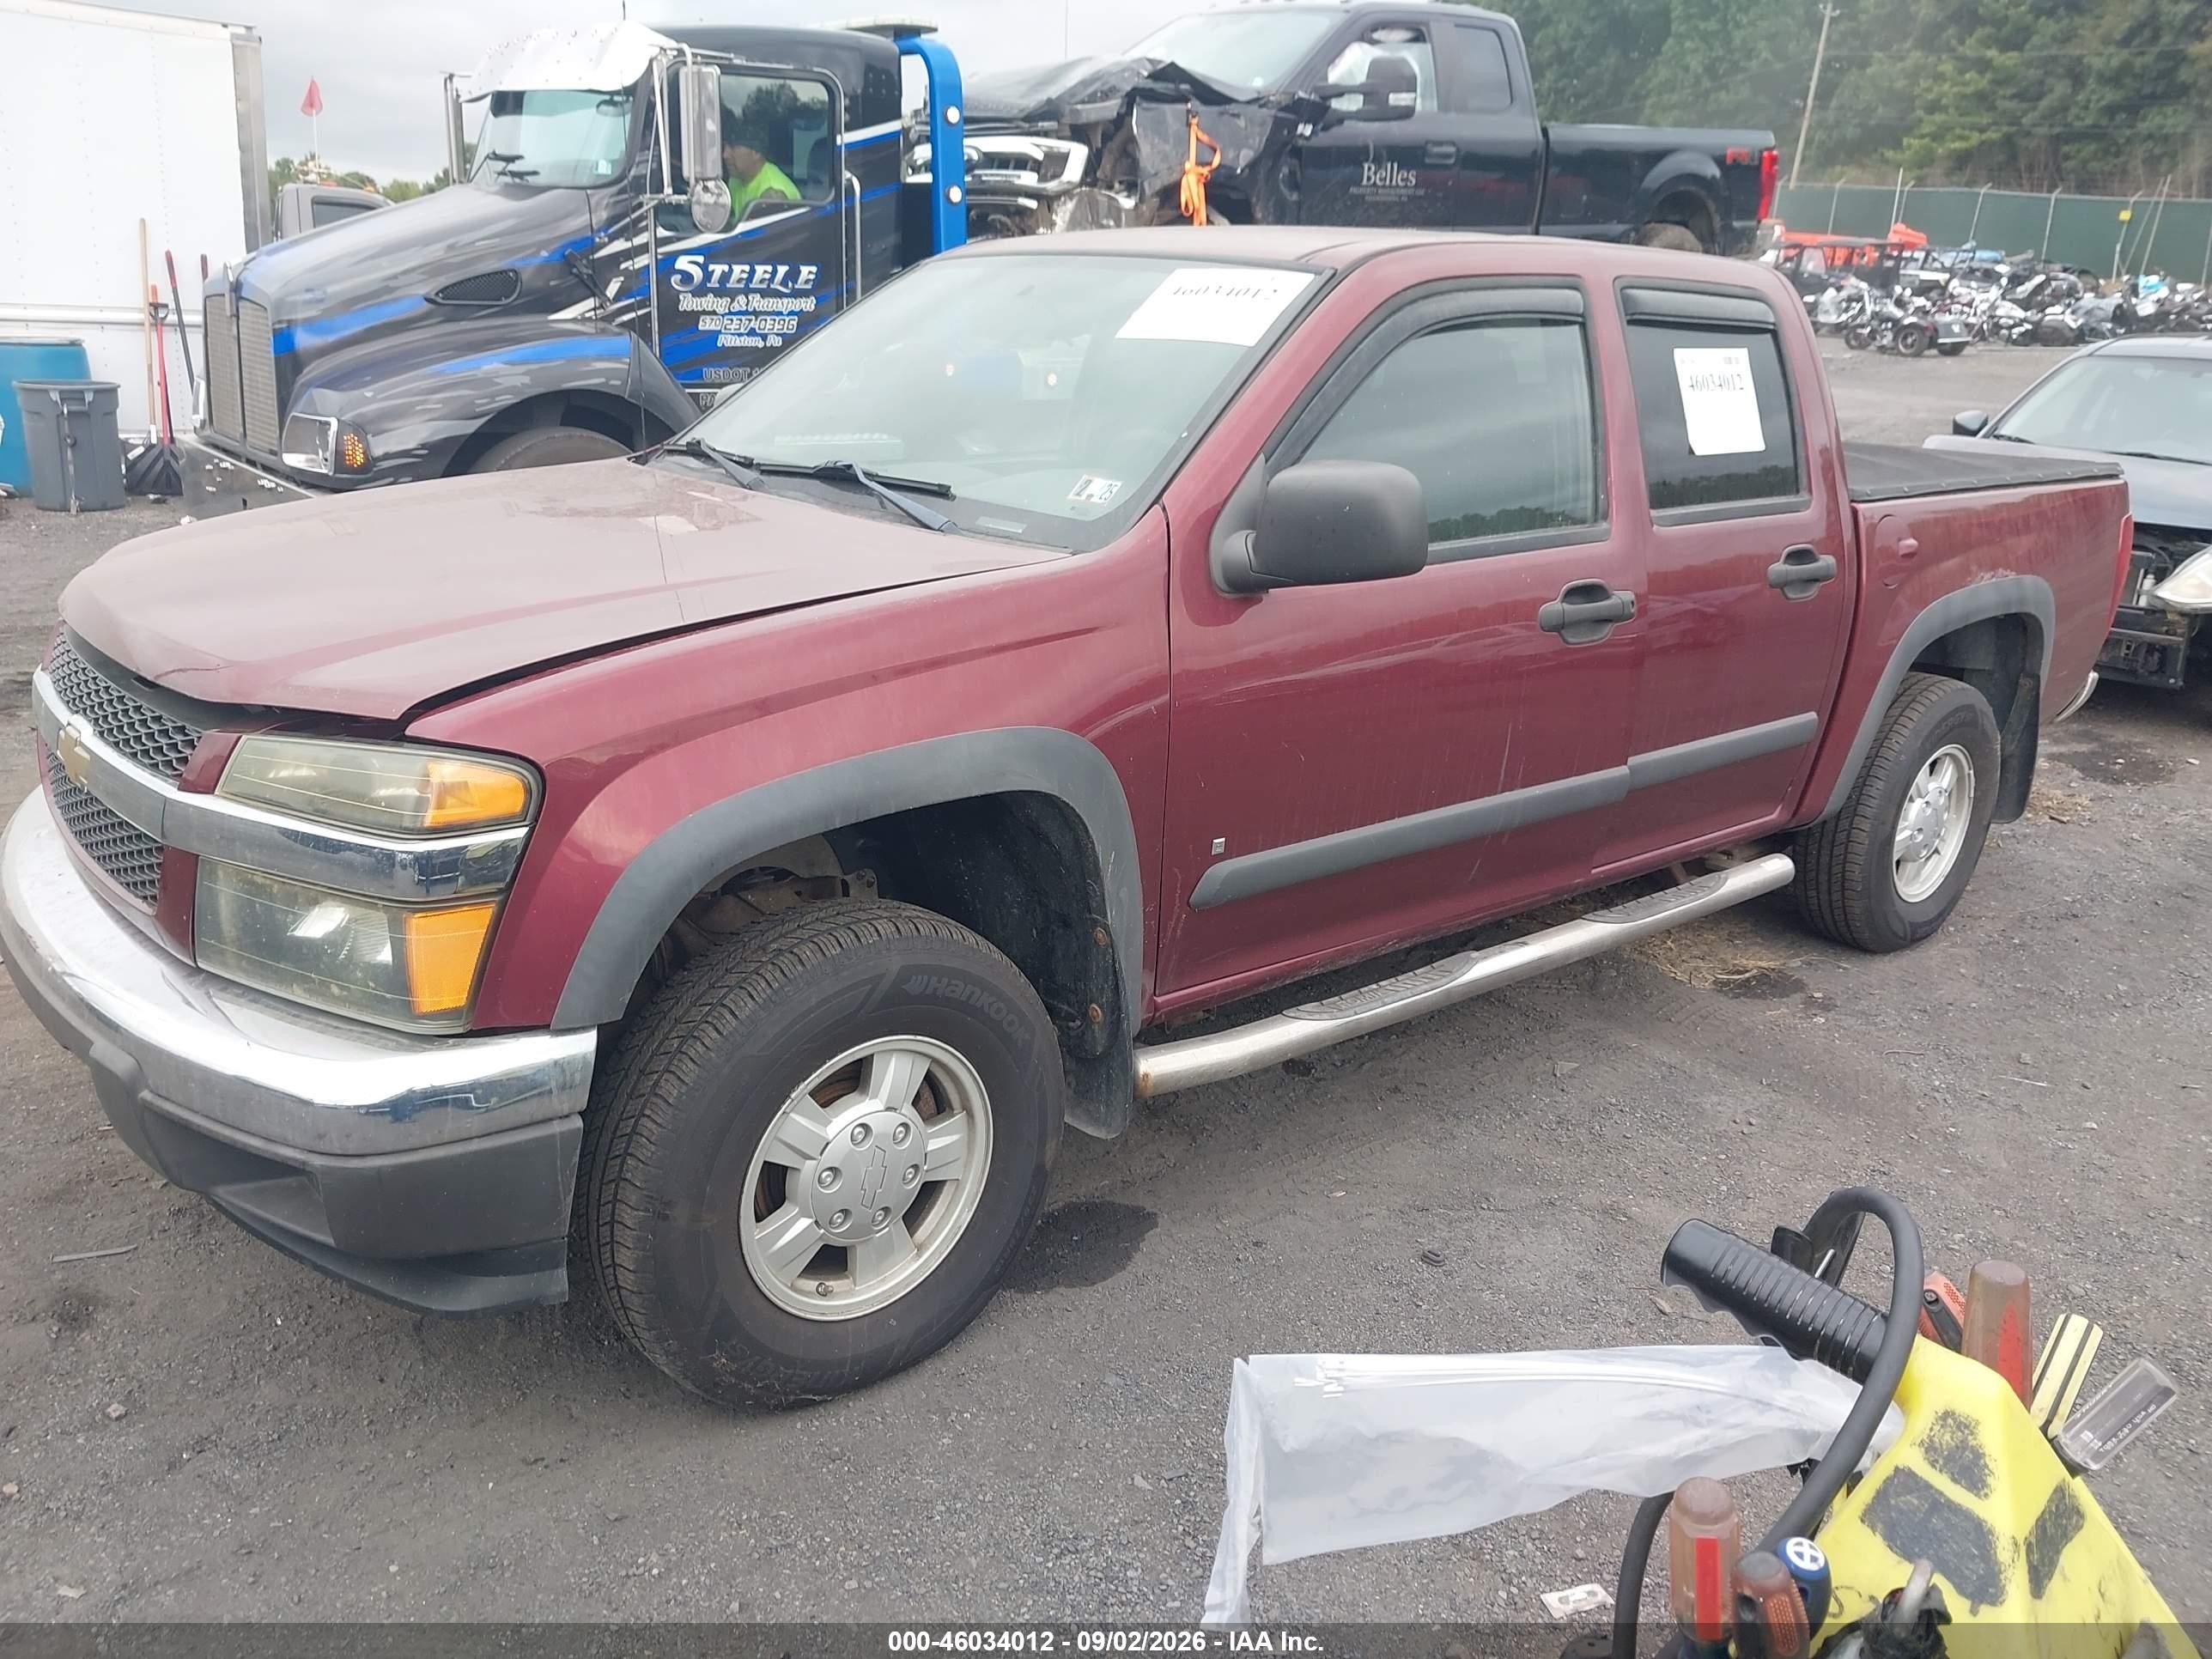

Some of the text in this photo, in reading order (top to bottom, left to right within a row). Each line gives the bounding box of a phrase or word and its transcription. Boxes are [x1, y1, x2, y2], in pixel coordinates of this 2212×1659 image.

[1361, 161, 1416, 186] Belles
[679, 293, 816, 314] Towing & Transport
[699, 315, 798, 333] 570 237-0396
[702, 368, 750, 381] USDOT
